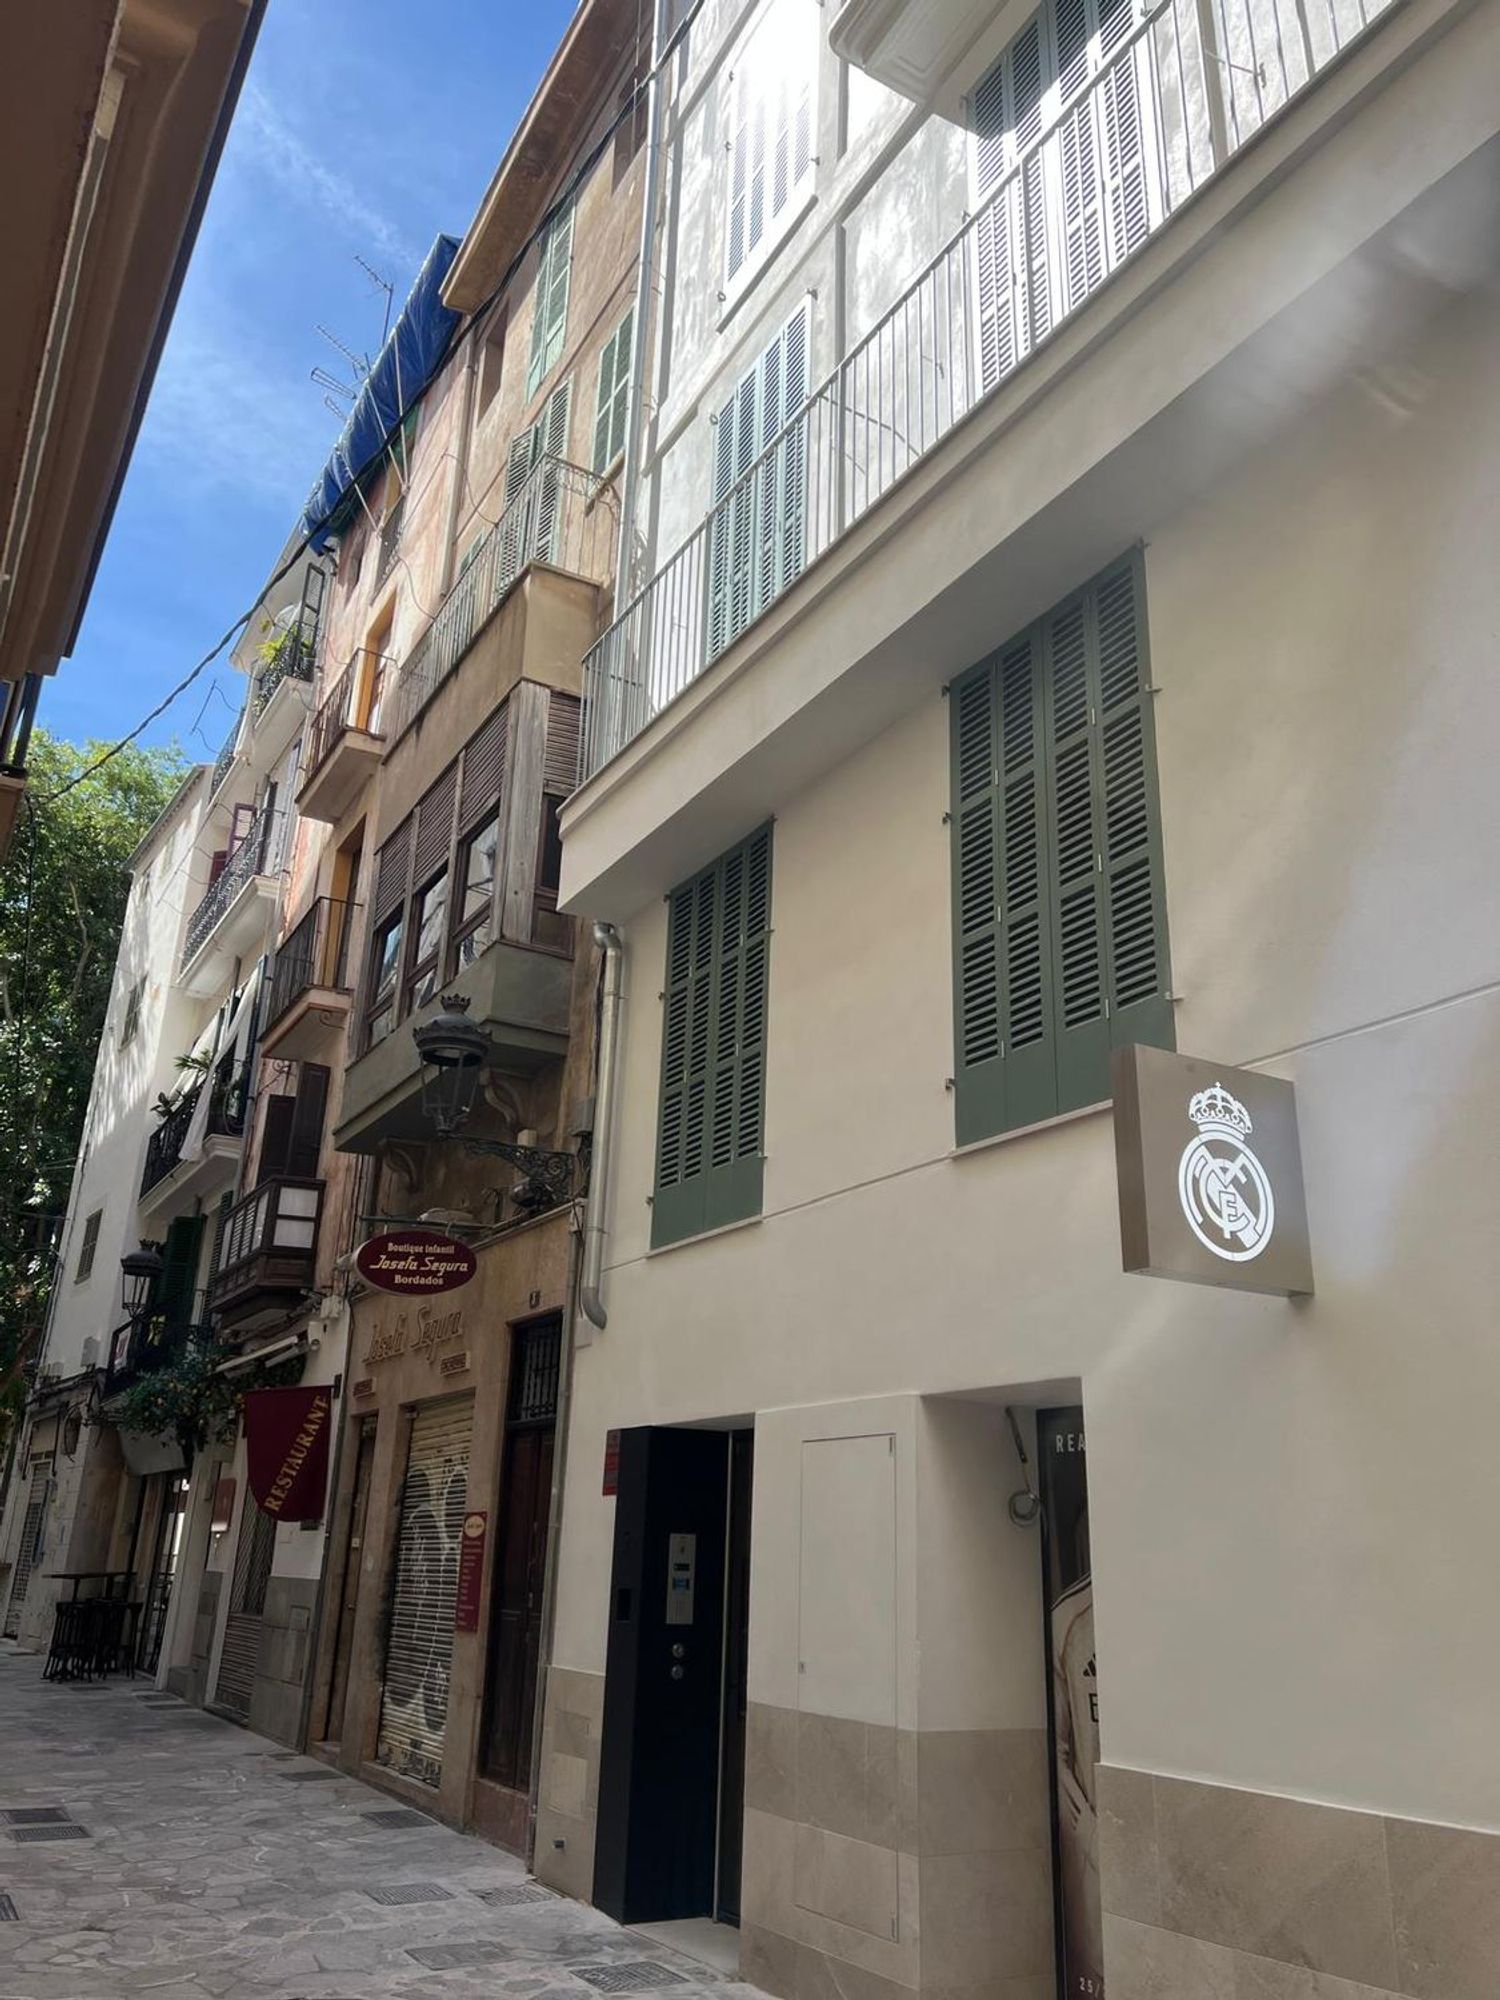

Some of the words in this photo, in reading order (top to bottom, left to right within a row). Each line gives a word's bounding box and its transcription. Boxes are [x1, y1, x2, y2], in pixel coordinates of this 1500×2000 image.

[387, 1242, 424, 1254] Boutique
[425, 1243, 456, 1255] Infantil
[368, 1255, 419, 1270] Josefa
[419, 1256, 469, 1277] Segura
[394, 1274, 445, 1286] Bordados
[263, 1395, 329, 1512] RESTAURANT
